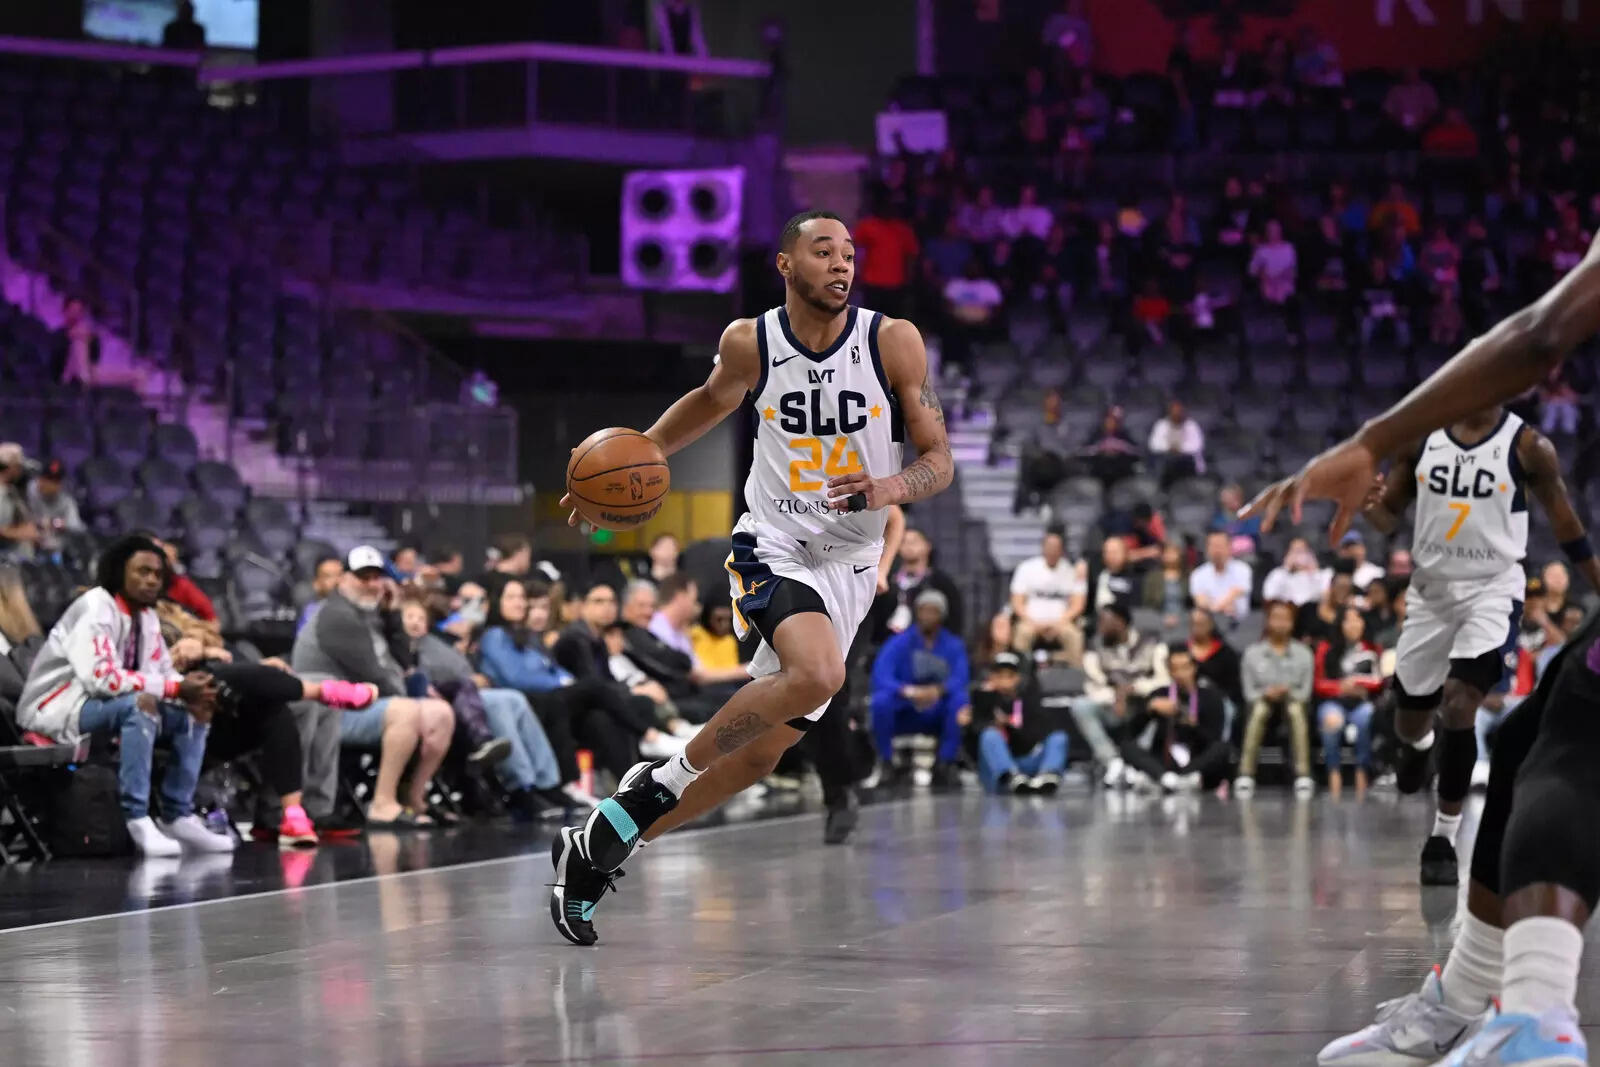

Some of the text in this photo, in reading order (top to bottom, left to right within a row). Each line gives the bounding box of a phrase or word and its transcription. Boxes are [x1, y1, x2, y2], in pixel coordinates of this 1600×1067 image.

[780, 389, 867, 436] SLC
[788, 436, 863, 492] 24
[1428, 465, 1496, 499] SLC
[773, 499, 830, 515] ZIONS
[1445, 503, 1471, 541] 7
[1456, 546, 1497, 561] BANK
